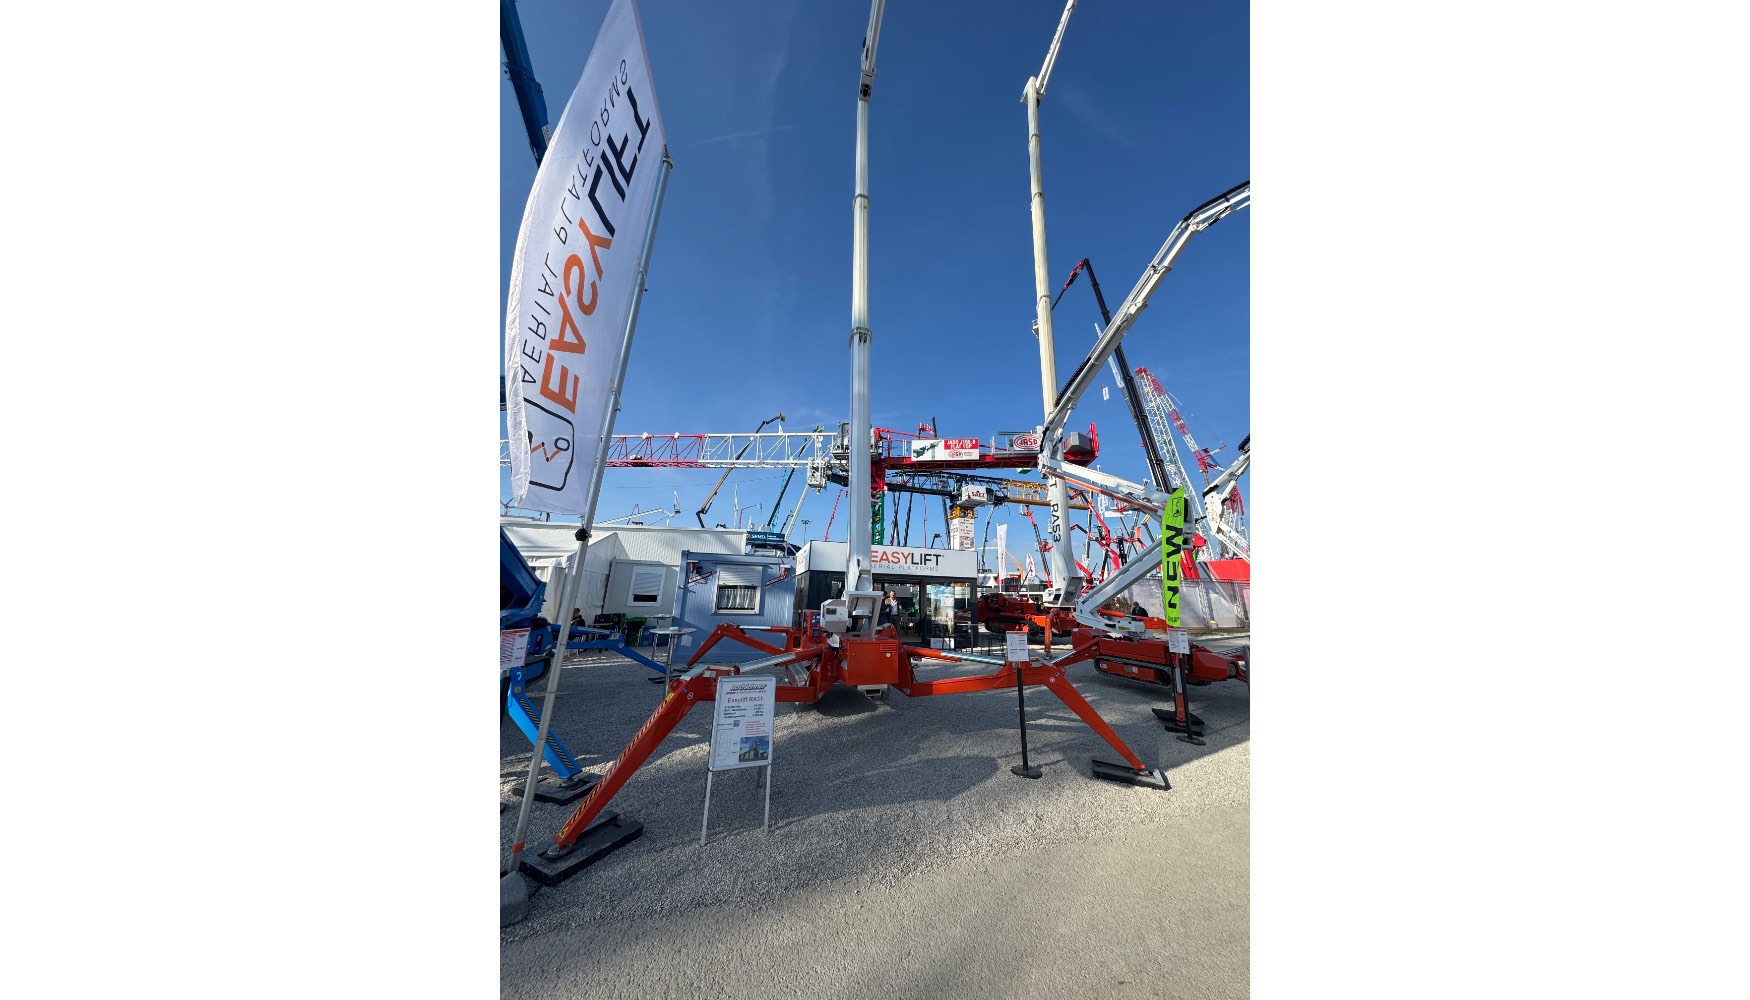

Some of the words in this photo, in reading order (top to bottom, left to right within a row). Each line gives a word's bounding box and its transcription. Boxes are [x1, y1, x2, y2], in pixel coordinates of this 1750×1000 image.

[1051, 503, 1061, 543] RA53
[871, 550, 941, 566] EASYLIFT
[1165, 524, 1183, 609] NEW
